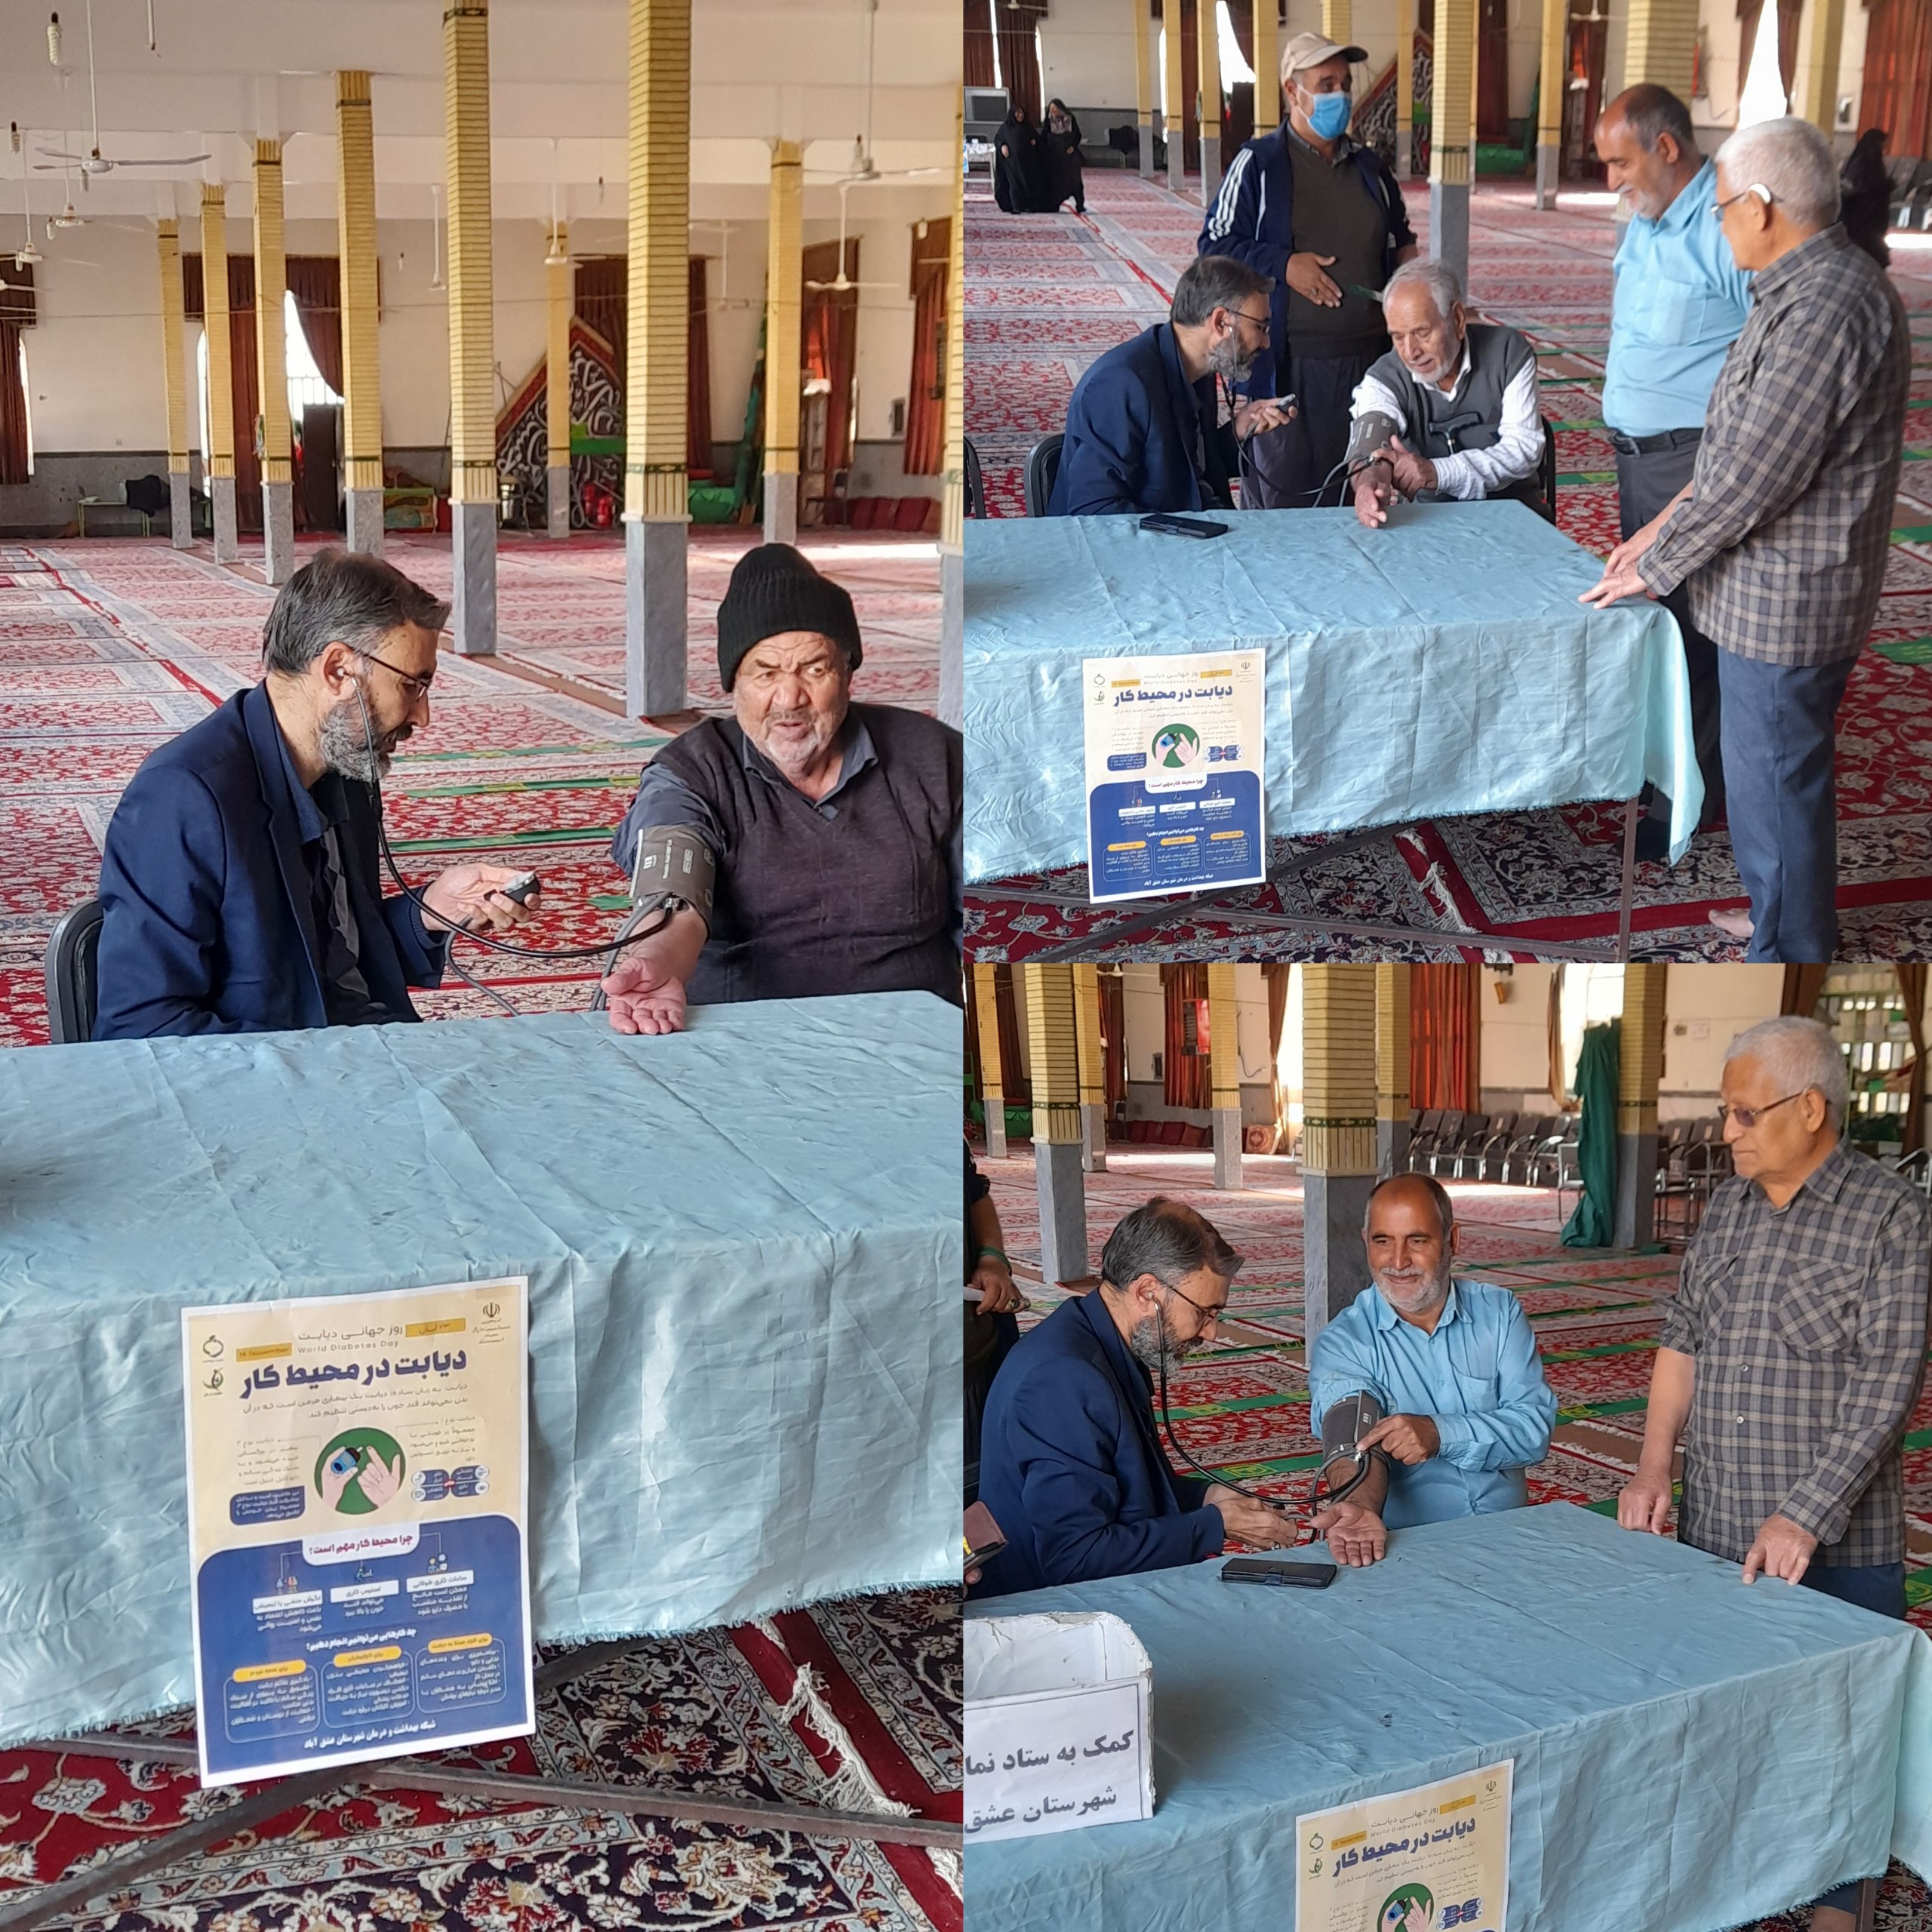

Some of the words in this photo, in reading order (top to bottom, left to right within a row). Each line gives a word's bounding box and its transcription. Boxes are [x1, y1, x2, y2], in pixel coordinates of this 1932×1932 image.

[1113, 689, 1134, 707] کار
[1137, 688, 1176, 703] محیط
[1177, 688, 1192, 703] در
[1194, 685, 1233, 700] دیابت
[298, 1329, 337, 1341] دیابت
[341, 1325, 386, 1340] جهانی
[388, 1325, 403, 1336] روز
[298, 1345, 327, 1354] World
[331, 1343, 377, 1352] Diabetes
[380, 1340, 398, 1349] Day
[361, 1358, 390, 1386] در
[395, 1349, 467, 1380] دیابت
[239, 1363, 281, 1399] کار
[286, 1363, 360, 1390] محیط
[355, 1539, 370, 1551] کار
[372, 1537, 398, 1547] محیط
[399, 1534, 413, 1546] چرا
[336, 1542, 355, 1554] مهم
[393, 1723, 419, 1735] بهداشت
[420, 1719, 436, 1730] شبکه
[336, 1730, 365, 1746] شهرستان
[366, 1727, 387, 1741] درمان
[388, 1729, 393, 1737] و
[303, 1737, 318, 1749] آباد
[319, 1737, 335, 1749] عشق
[1083, 1730, 1134, 1758] کمک
[1002, 1747, 1049, 1770] ستاد
[1057, 1745, 1076, 1766] به
[1023, 1786, 1116, 1823] شهرستان
[964, 1804, 1015, 1834] عشق
[1371, 1817, 1397, 1828] دیابت
[1399, 1809, 1428, 1823] جهانی
[1370, 1828, 1390, 1838] World
[1392, 1822, 1422, 1832] Diabetes
[1432, 1817, 1475, 1844] دیابت
[1361, 1838, 1410, 1863] محیط
[1410, 1832, 1429, 1854] در
[1332, 1847, 1358, 1878] کار
